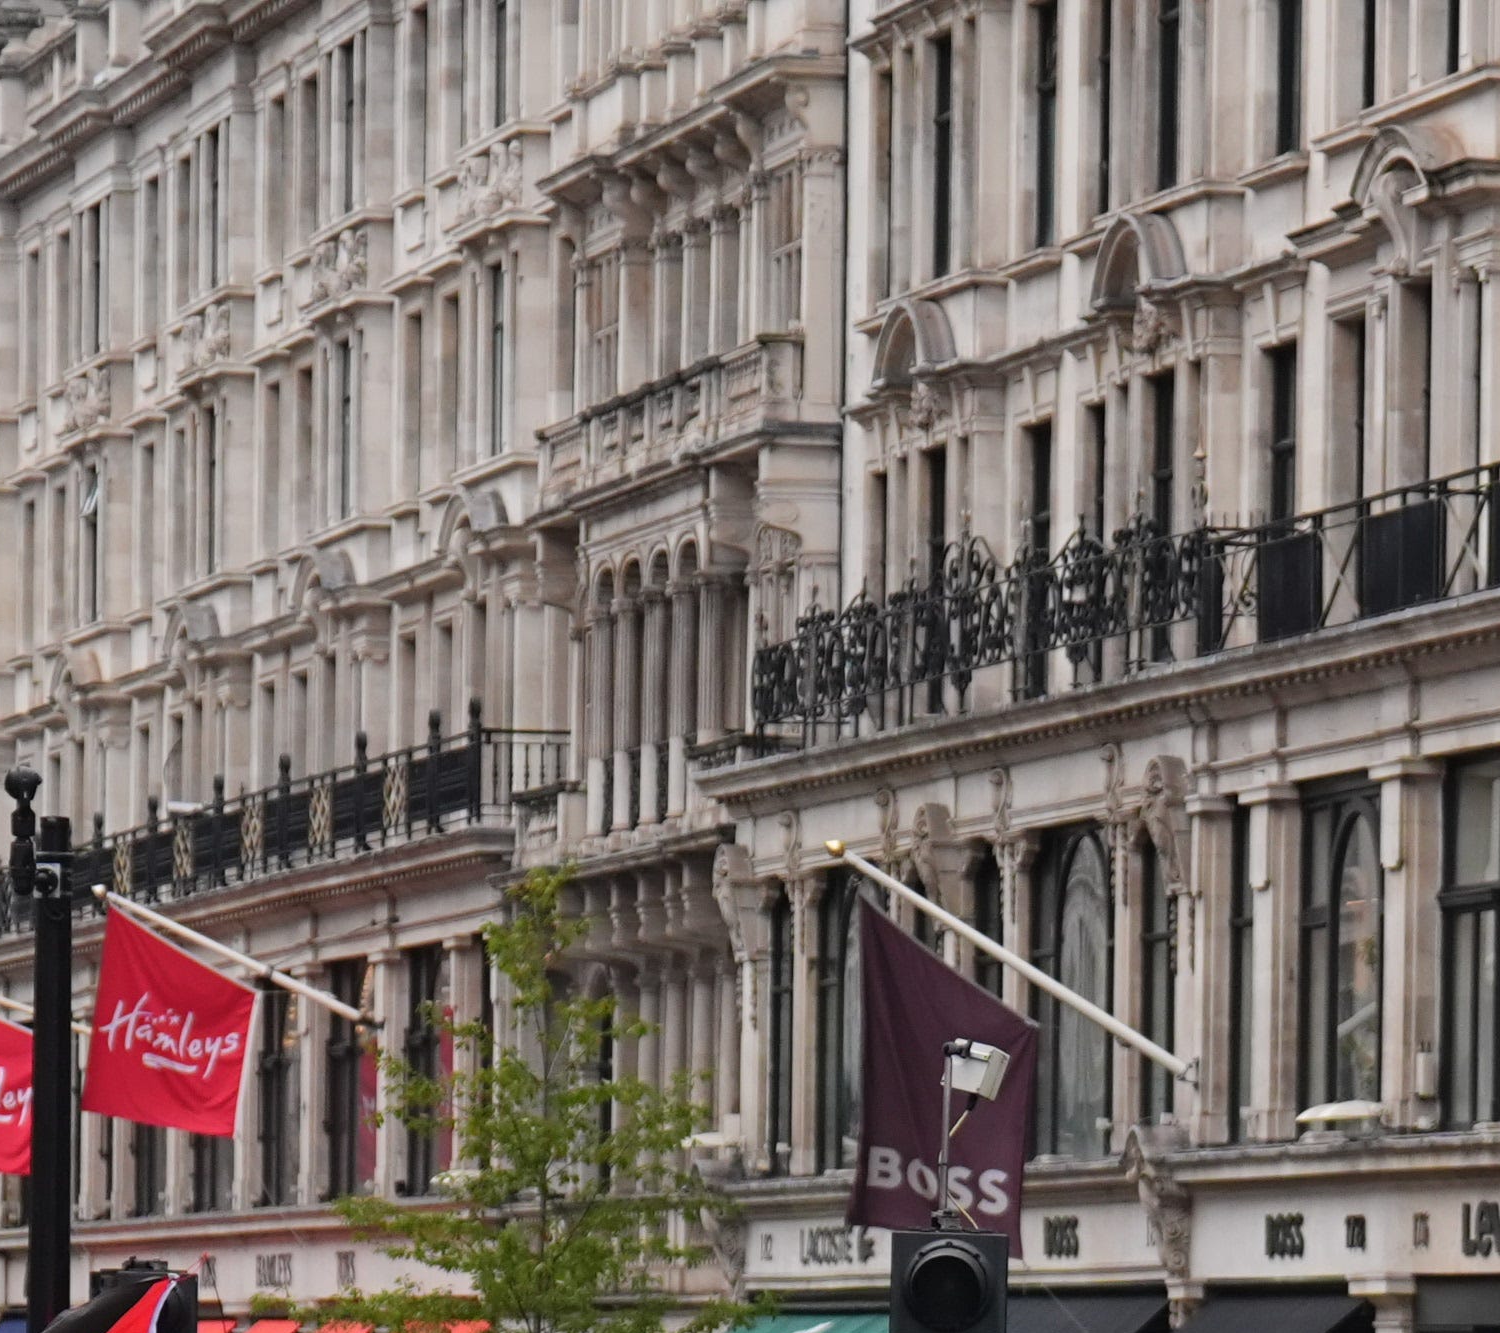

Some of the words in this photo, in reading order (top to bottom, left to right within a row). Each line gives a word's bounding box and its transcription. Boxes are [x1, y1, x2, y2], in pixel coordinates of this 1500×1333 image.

[100, 993, 240, 1080] Hamleys
[867, 1147, 1009, 1215] BOSS
[1044, 1215, 1079, 1259] BOSS
[1264, 1213, 1305, 1259] BOSS
